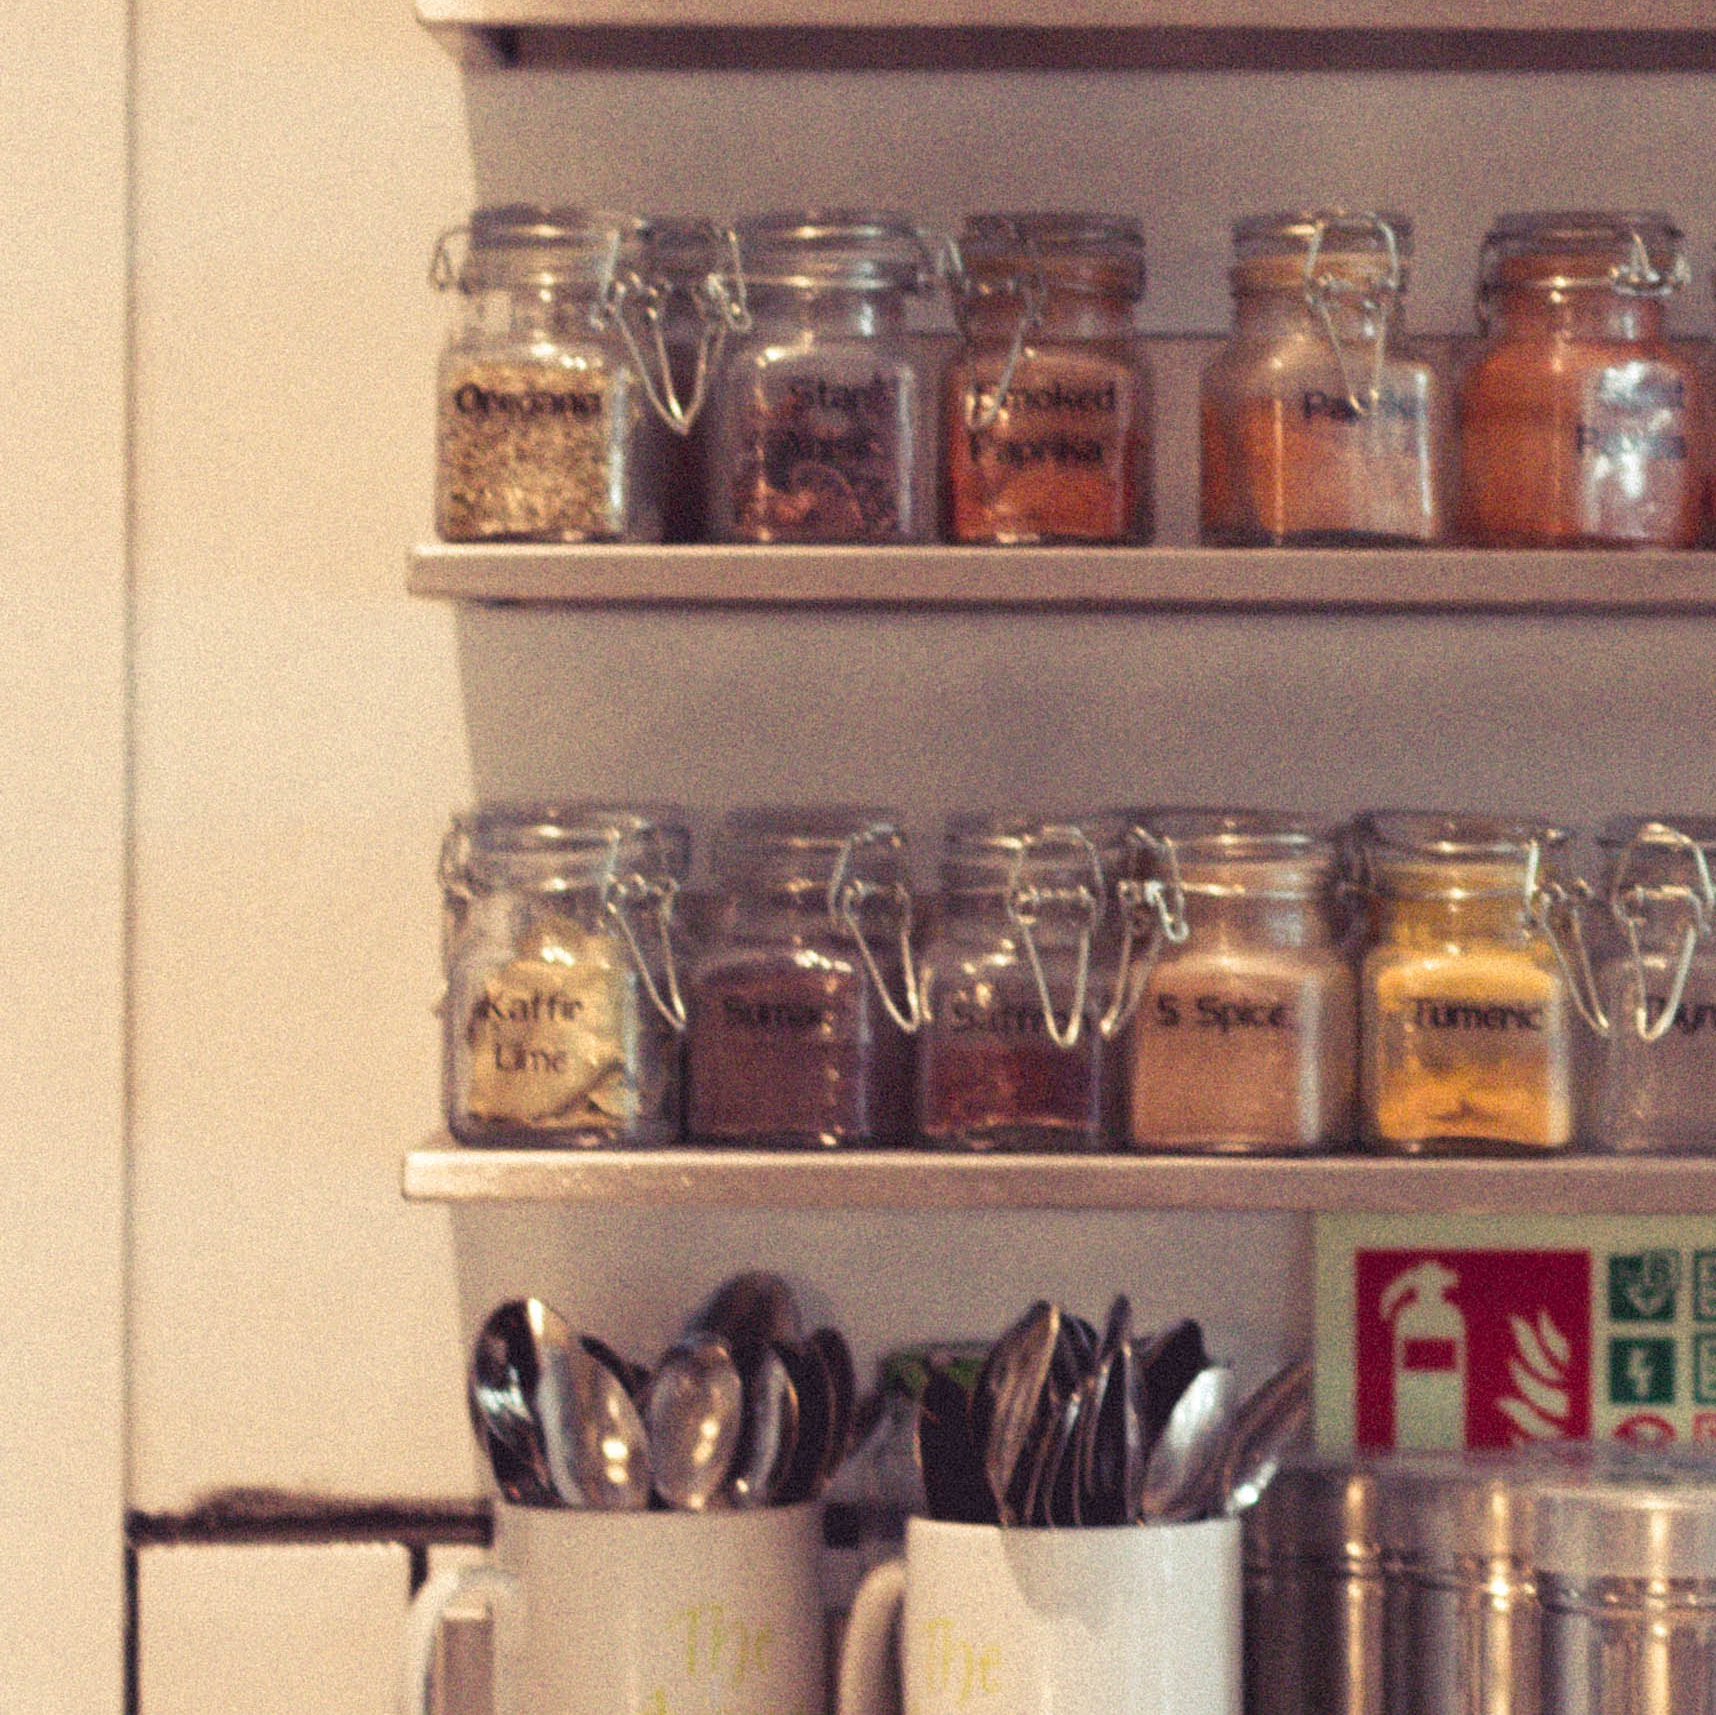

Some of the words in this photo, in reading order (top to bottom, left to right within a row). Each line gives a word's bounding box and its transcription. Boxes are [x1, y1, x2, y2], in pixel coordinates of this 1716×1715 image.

[452, 382, 602, 416] Oregano
[479, 990, 583, 1025] Kaffir
[1196, 994, 1290, 1034] Spice
[1412, 995, 1544, 1032] Tumeric
[494, 1040, 568, 1073] Lime
